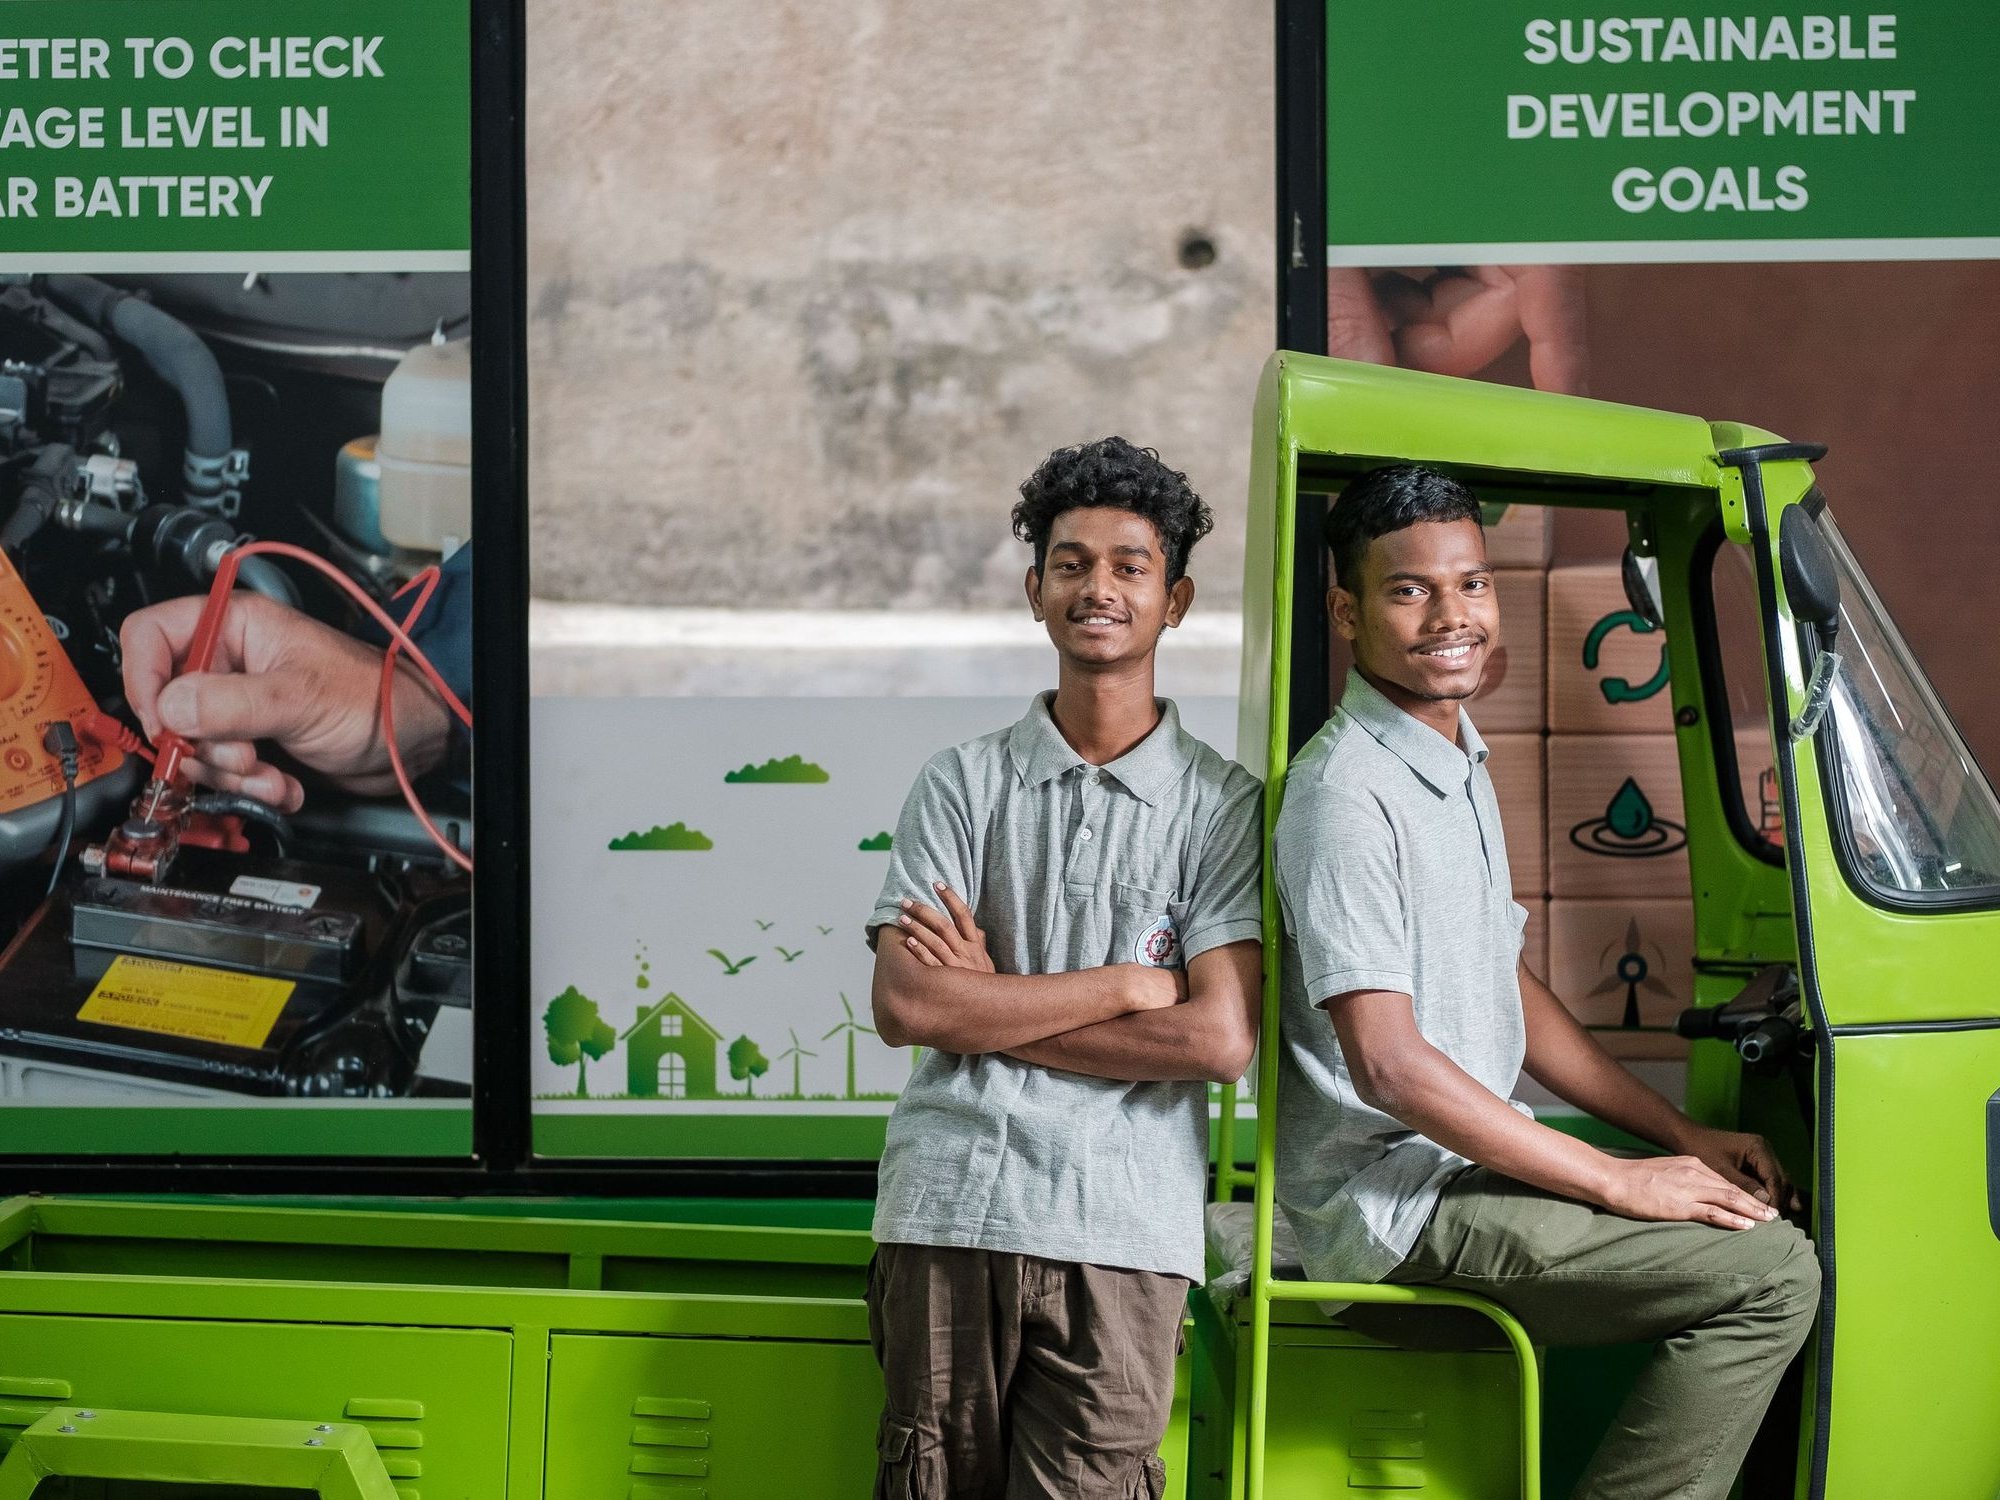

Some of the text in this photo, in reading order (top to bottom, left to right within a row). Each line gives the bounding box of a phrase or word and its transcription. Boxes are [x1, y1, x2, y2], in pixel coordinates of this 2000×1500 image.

[0, 36, 386, 79] ETER TO CHECK
[1523, 14, 1897, 65] SUSTAINABLE
[0, 106, 329, 149] AGE LEVEL IN
[1507, 89, 1917, 139] DEVELOPMENT
[0, 175, 274, 218] R BATTERY
[1611, 165, 1809, 213] GOALS
